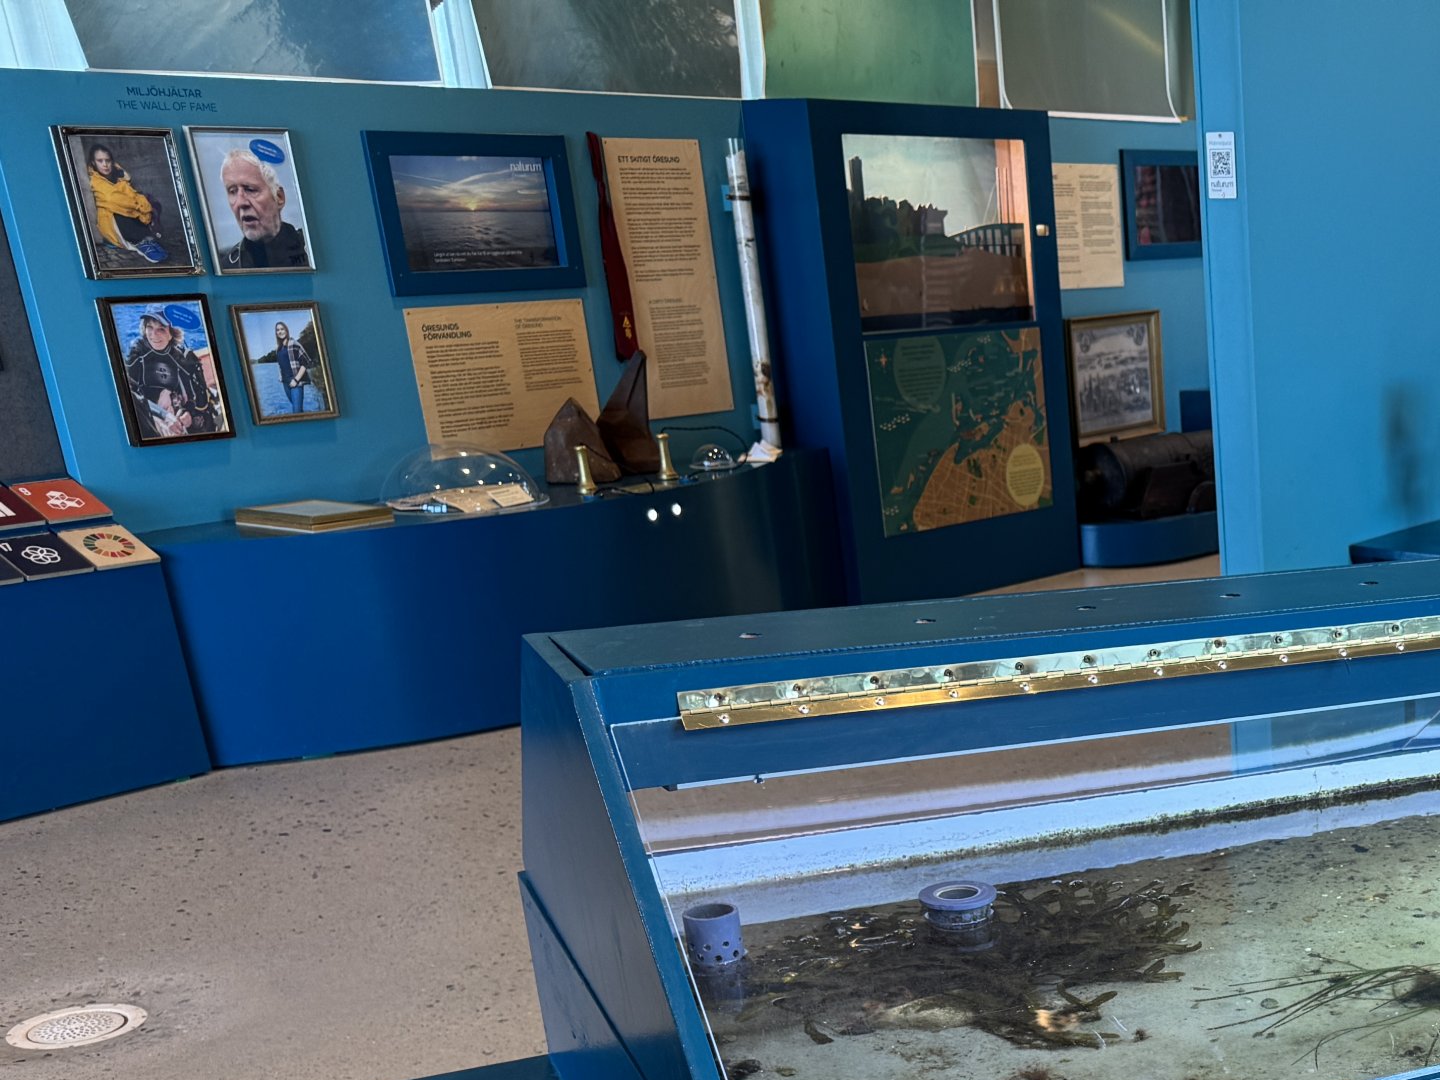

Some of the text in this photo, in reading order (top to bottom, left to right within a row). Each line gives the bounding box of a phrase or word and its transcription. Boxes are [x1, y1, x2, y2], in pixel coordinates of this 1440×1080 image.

[125, 85, 202, 98] MILJÖHJÄLTAR
[116, 99, 218, 113] THE WALL OF FAME
[421, 322, 459, 333] ÖRESUNDS
[423, 331, 472, 341] FÖRVANDLING
[18, 487, 32, 496] 8
